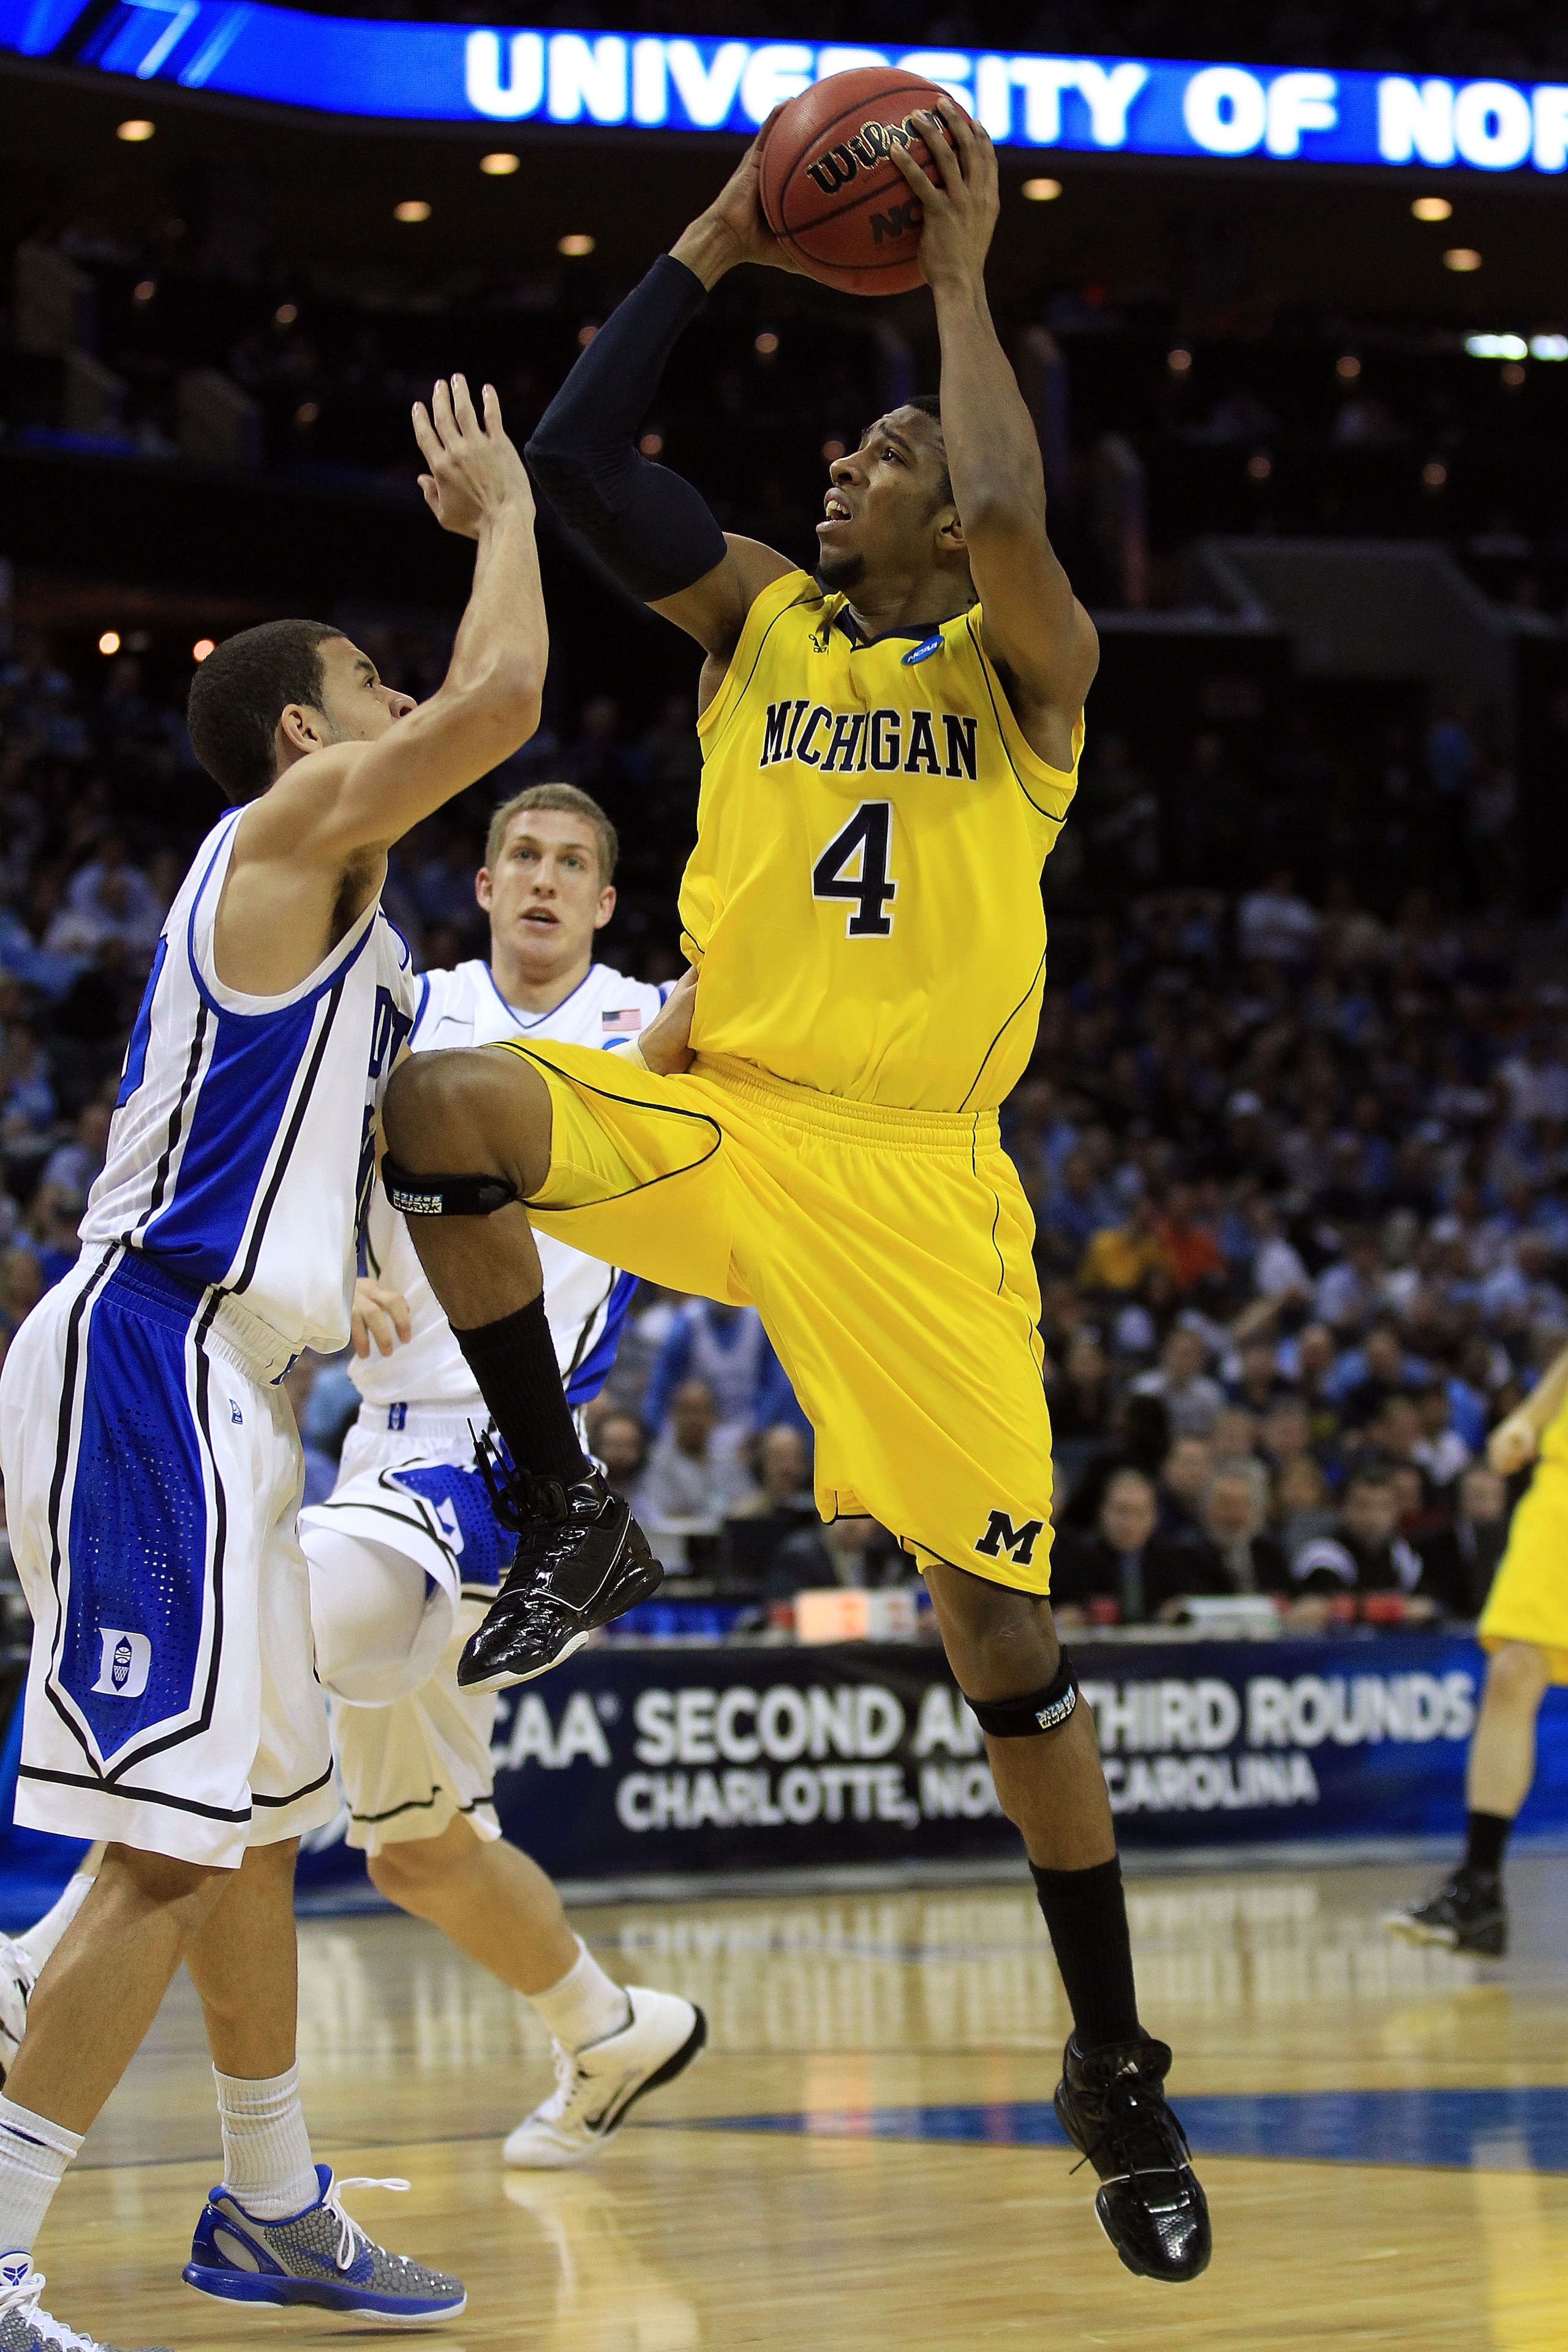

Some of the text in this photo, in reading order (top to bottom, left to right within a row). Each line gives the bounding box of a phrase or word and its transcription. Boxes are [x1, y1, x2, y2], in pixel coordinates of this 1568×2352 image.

[466, 29, 1148, 147] UNIVESITY
[1183, 66, 1339, 159] OF
[758, 699, 979, 782] MICHIGAN
[812, 799, 899, 940] 4
[973, 1507, 1045, 1568] M
[633, 1683, 905, 1765] SECOND
[1246, 1671, 1476, 1749] ROUNDS
[616, 1762, 920, 1833] CHARLOTTE,
